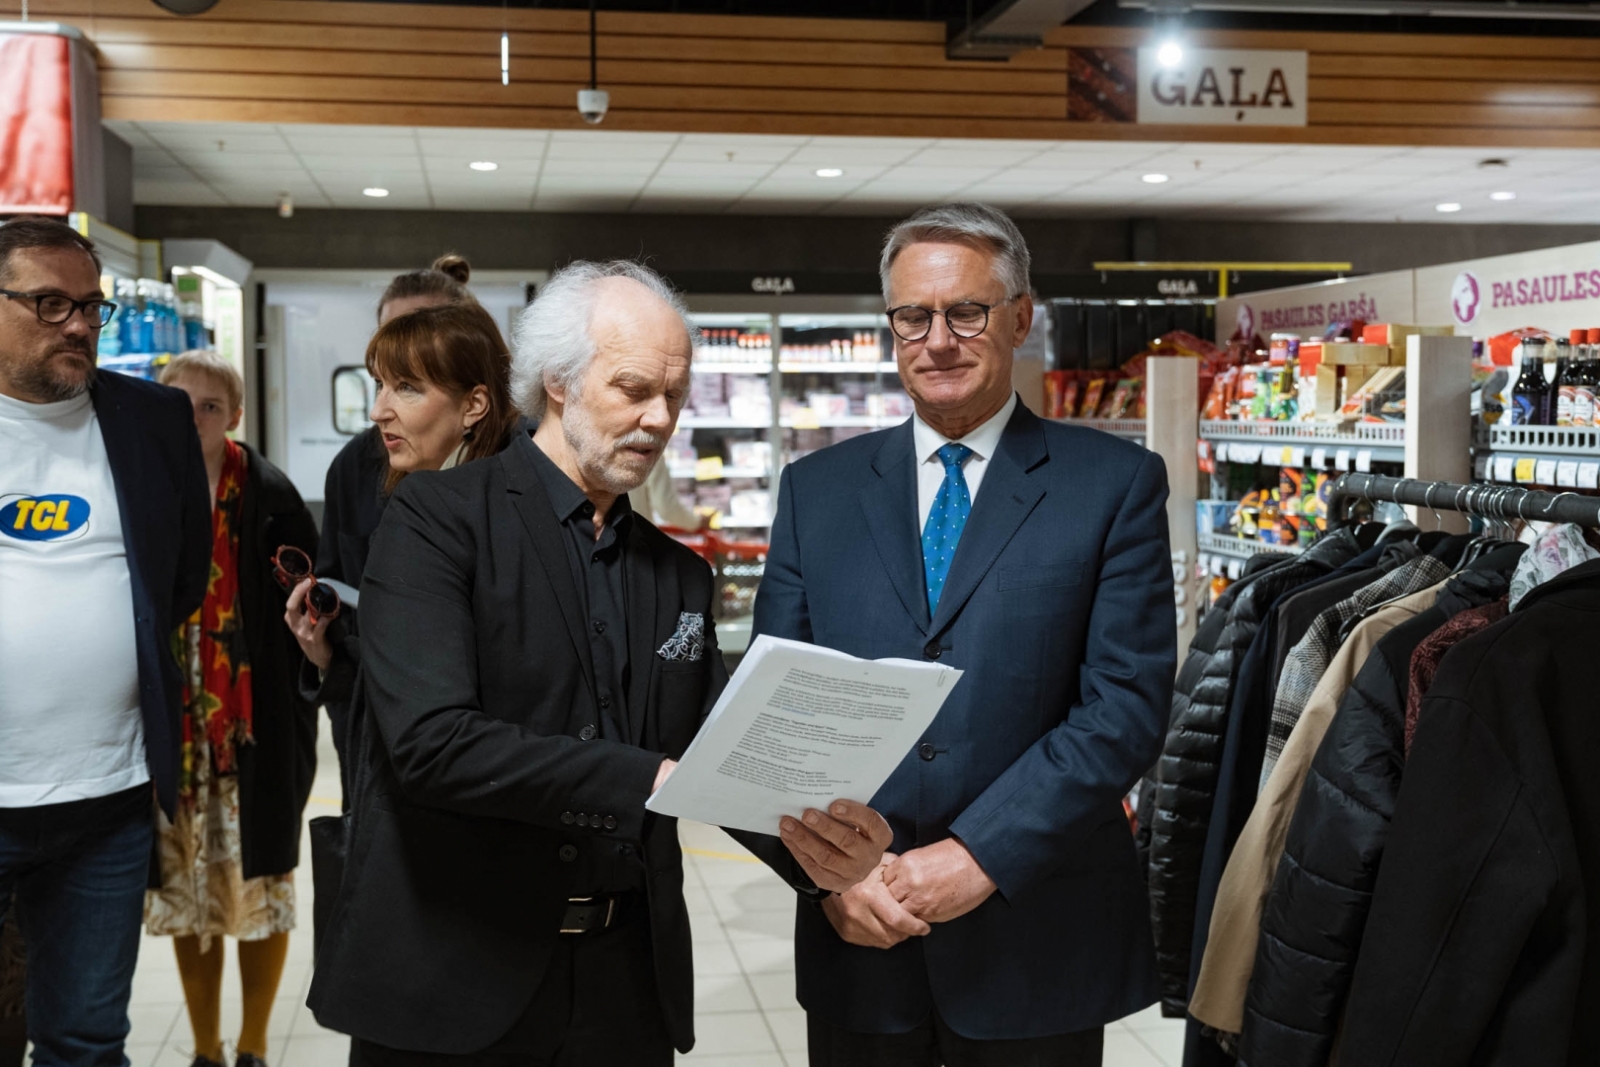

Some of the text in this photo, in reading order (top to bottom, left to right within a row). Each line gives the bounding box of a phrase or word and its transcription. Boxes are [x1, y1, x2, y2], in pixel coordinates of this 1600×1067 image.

[1151, 67, 1294, 121] GAĻA
[1492, 269, 1600, 308] PASAULES
[1261, 292, 1378, 331] PASAULES GARŠA
[13, 499, 70, 531] TCL
